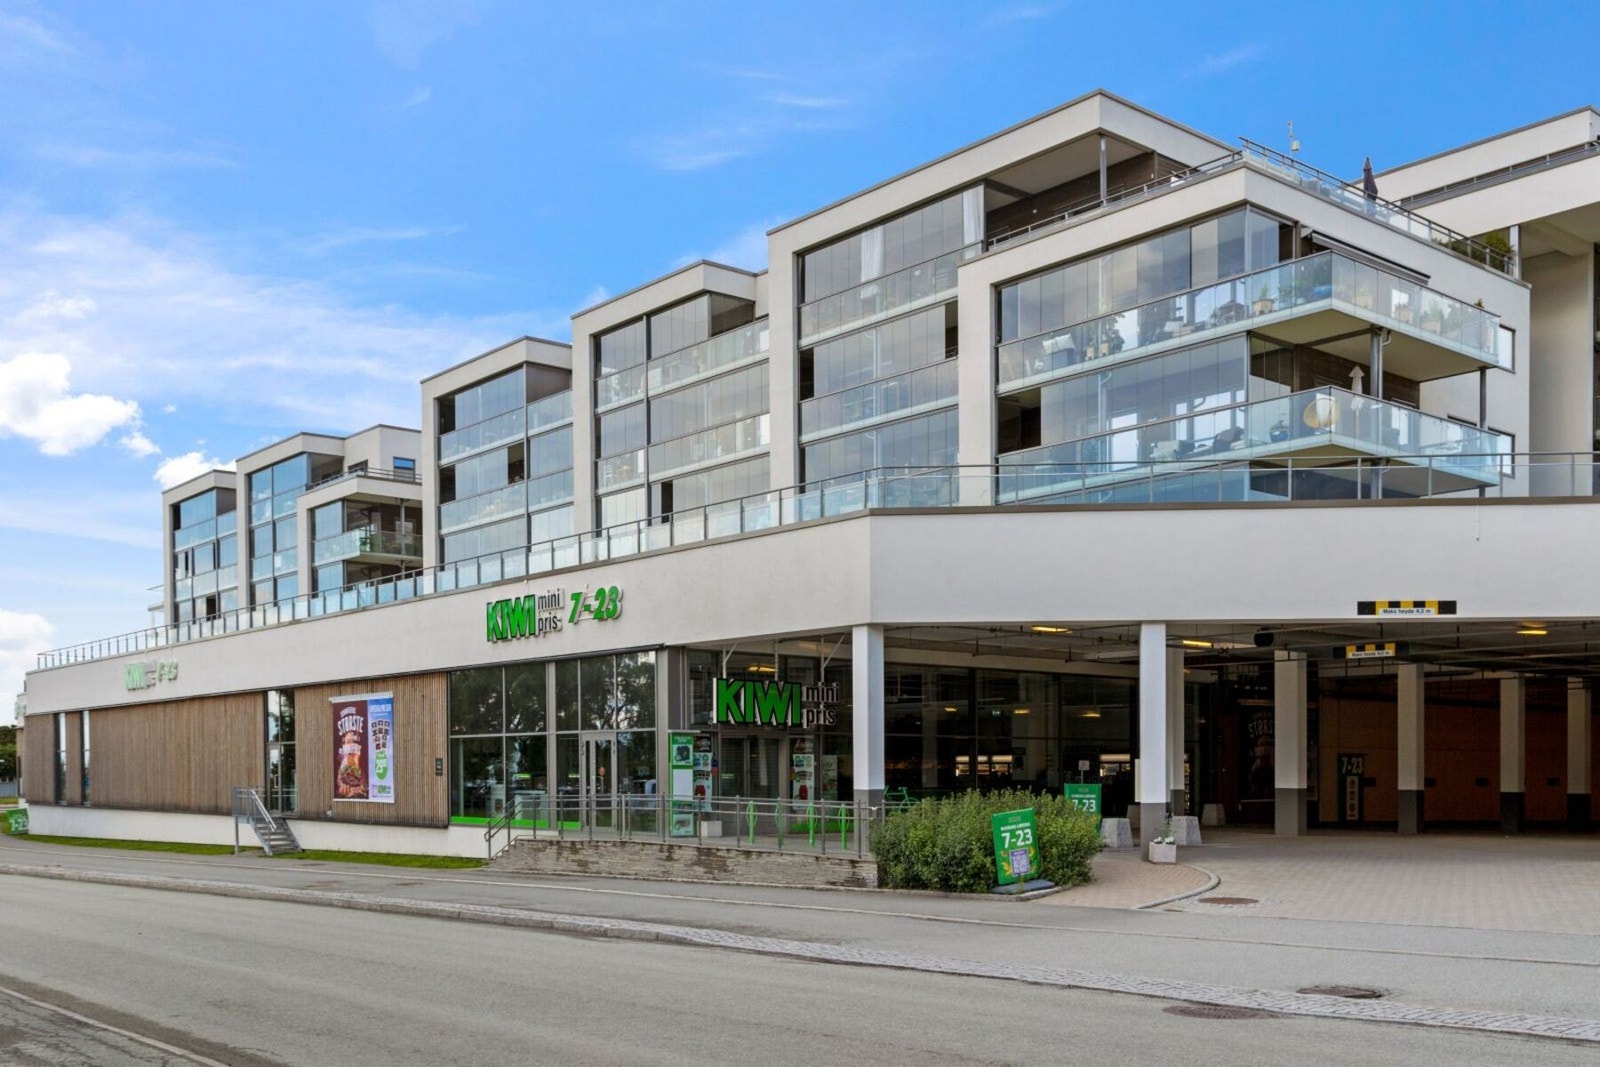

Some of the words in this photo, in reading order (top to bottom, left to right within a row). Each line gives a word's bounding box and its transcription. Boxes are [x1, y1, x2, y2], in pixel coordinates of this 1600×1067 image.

[487, 595, 536, 642] KIWI
[538, 588, 561, 610] mini
[569, 585, 623, 622] 7-23
[537, 612, 561, 636] pris
[714, 678, 802, 726] KIWI
[804, 682, 840, 704] mini
[804, 704, 838, 728] pris
[1001, 829, 1033, 848] 7-23
